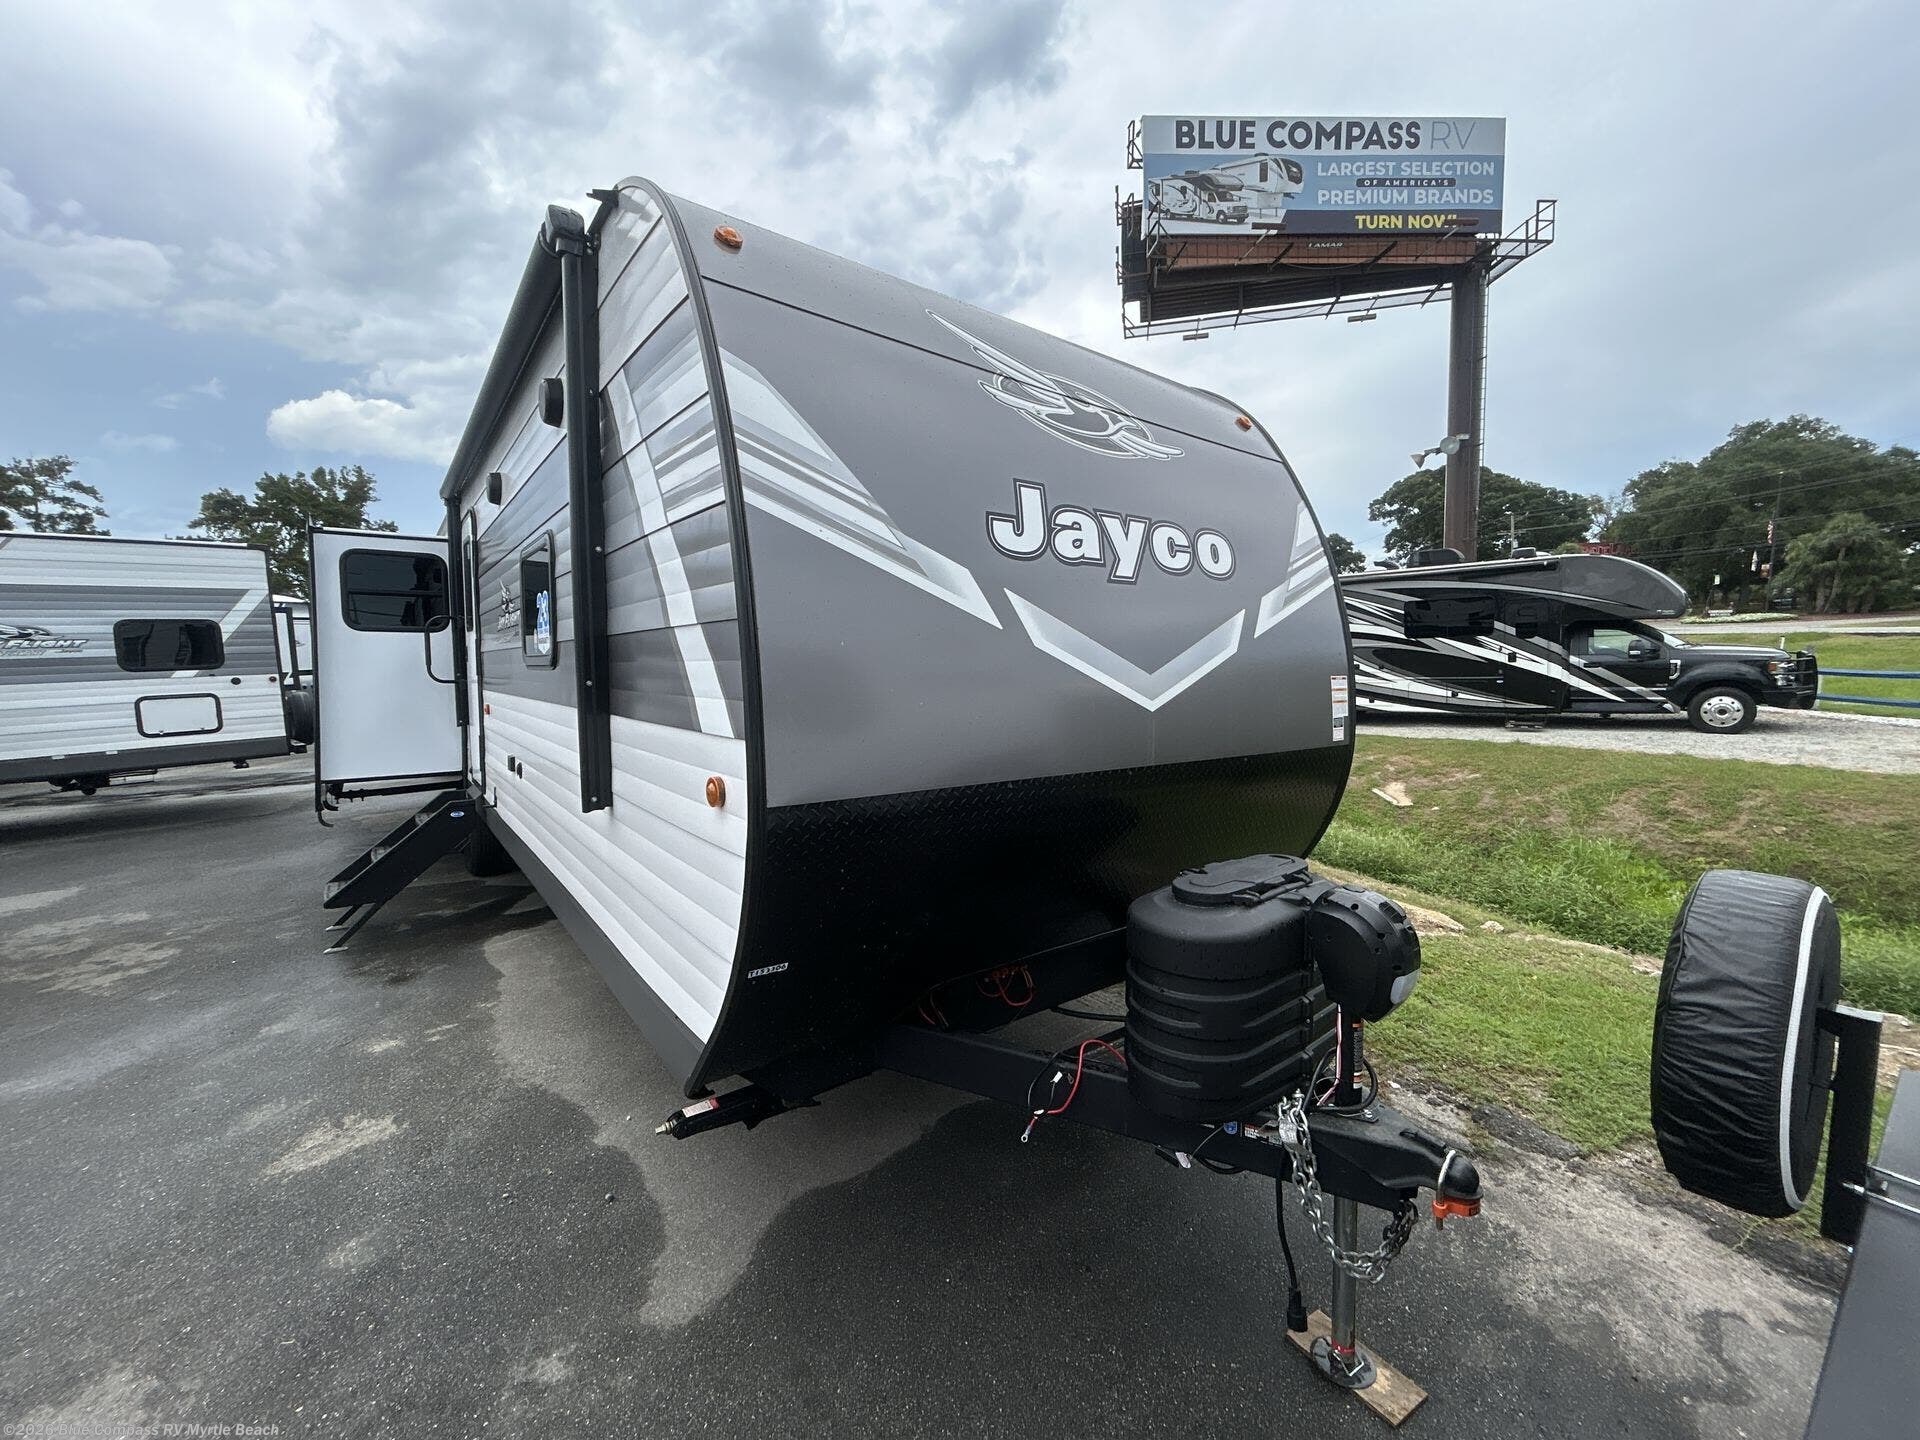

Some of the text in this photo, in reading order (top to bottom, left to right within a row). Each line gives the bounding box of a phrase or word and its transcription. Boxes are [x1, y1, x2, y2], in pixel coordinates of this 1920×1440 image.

[1175, 120, 1477, 150] BLUE COMPASS RV
[1317, 161, 1495, 177] LARGEST SELECTION
[1317, 189, 1494, 205] PREMIUM BRANDS
[1355, 215, 1402, 229] TURN
[986, 478, 1236, 585] Jayco
[5, 639, 89, 649] FLIGHT
